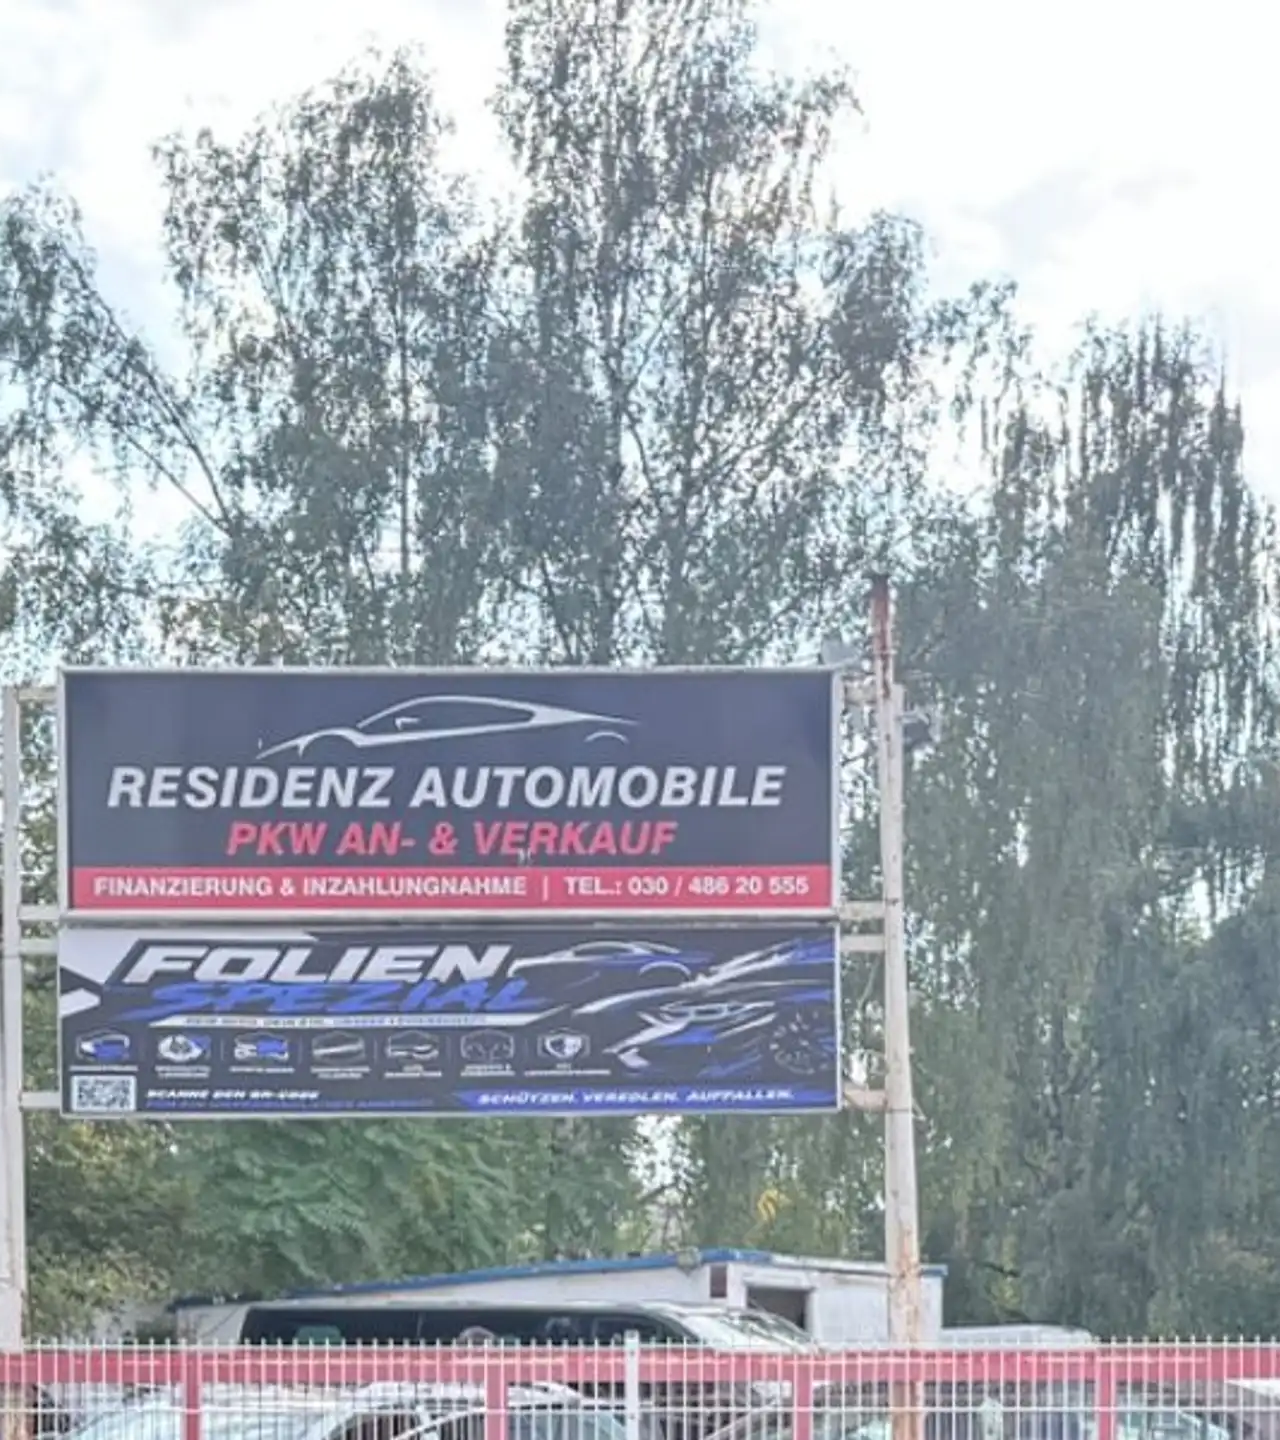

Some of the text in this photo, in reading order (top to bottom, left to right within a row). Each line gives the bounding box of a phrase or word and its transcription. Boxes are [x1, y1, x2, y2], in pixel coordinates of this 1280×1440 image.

[107, 766, 787, 808] RESIDENZ AUTOMOBILE
[226, 820, 679, 856] PKW AN- & VERKAUF
[93, 876, 272, 897] FINANZIERUNG
[279, 876, 296, 896] &
[303, 875, 527, 897] INZAHLUNGNAHME
[628, 875, 670, 896] 030
[688, 875, 730, 896] 486
[735, 875, 765, 896] 20
[769, 875, 810, 896] 555
[122, 944, 516, 984] FOLIEN
[122, 979, 540, 1018] SPEZIAL
